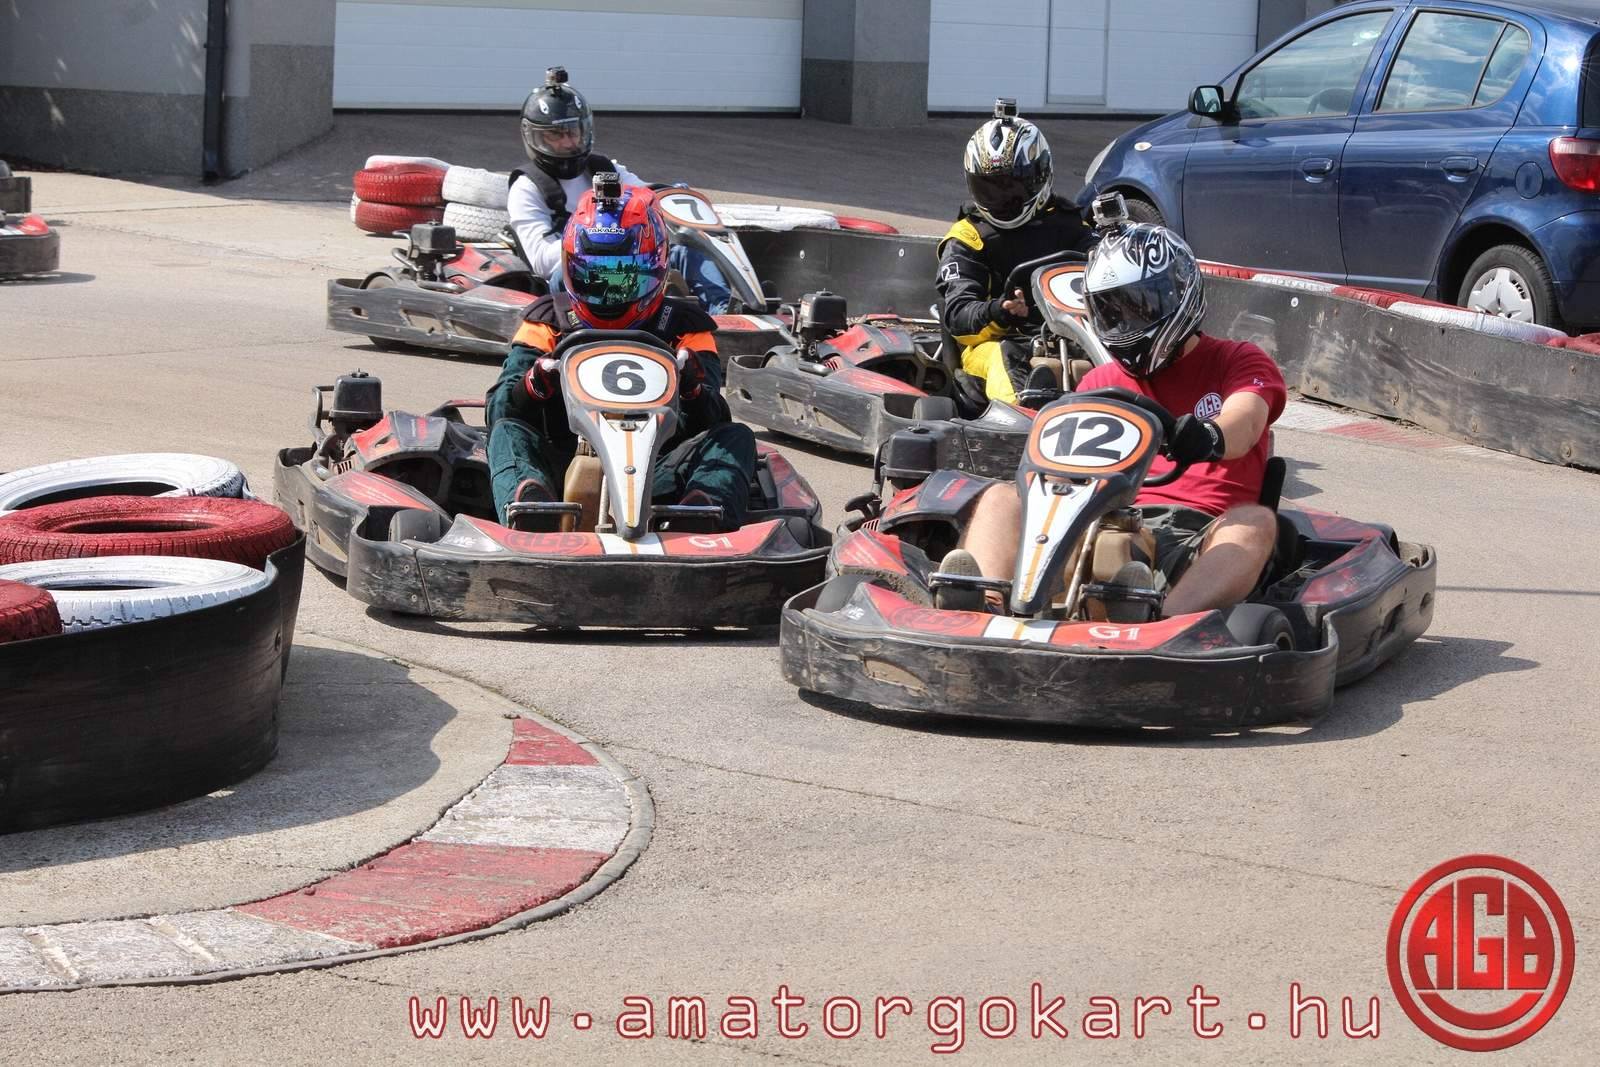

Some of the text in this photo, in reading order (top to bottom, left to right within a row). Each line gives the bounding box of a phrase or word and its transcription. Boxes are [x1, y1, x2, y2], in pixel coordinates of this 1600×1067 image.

[671, 198, 704, 220] 7
[601, 359, 646, 396] 6
[1195, 394, 1222, 418] AGB
[1042, 416, 1125, 460] 12
[688, 535, 733, 549] G1
[1088, 625, 1140, 641] G1
